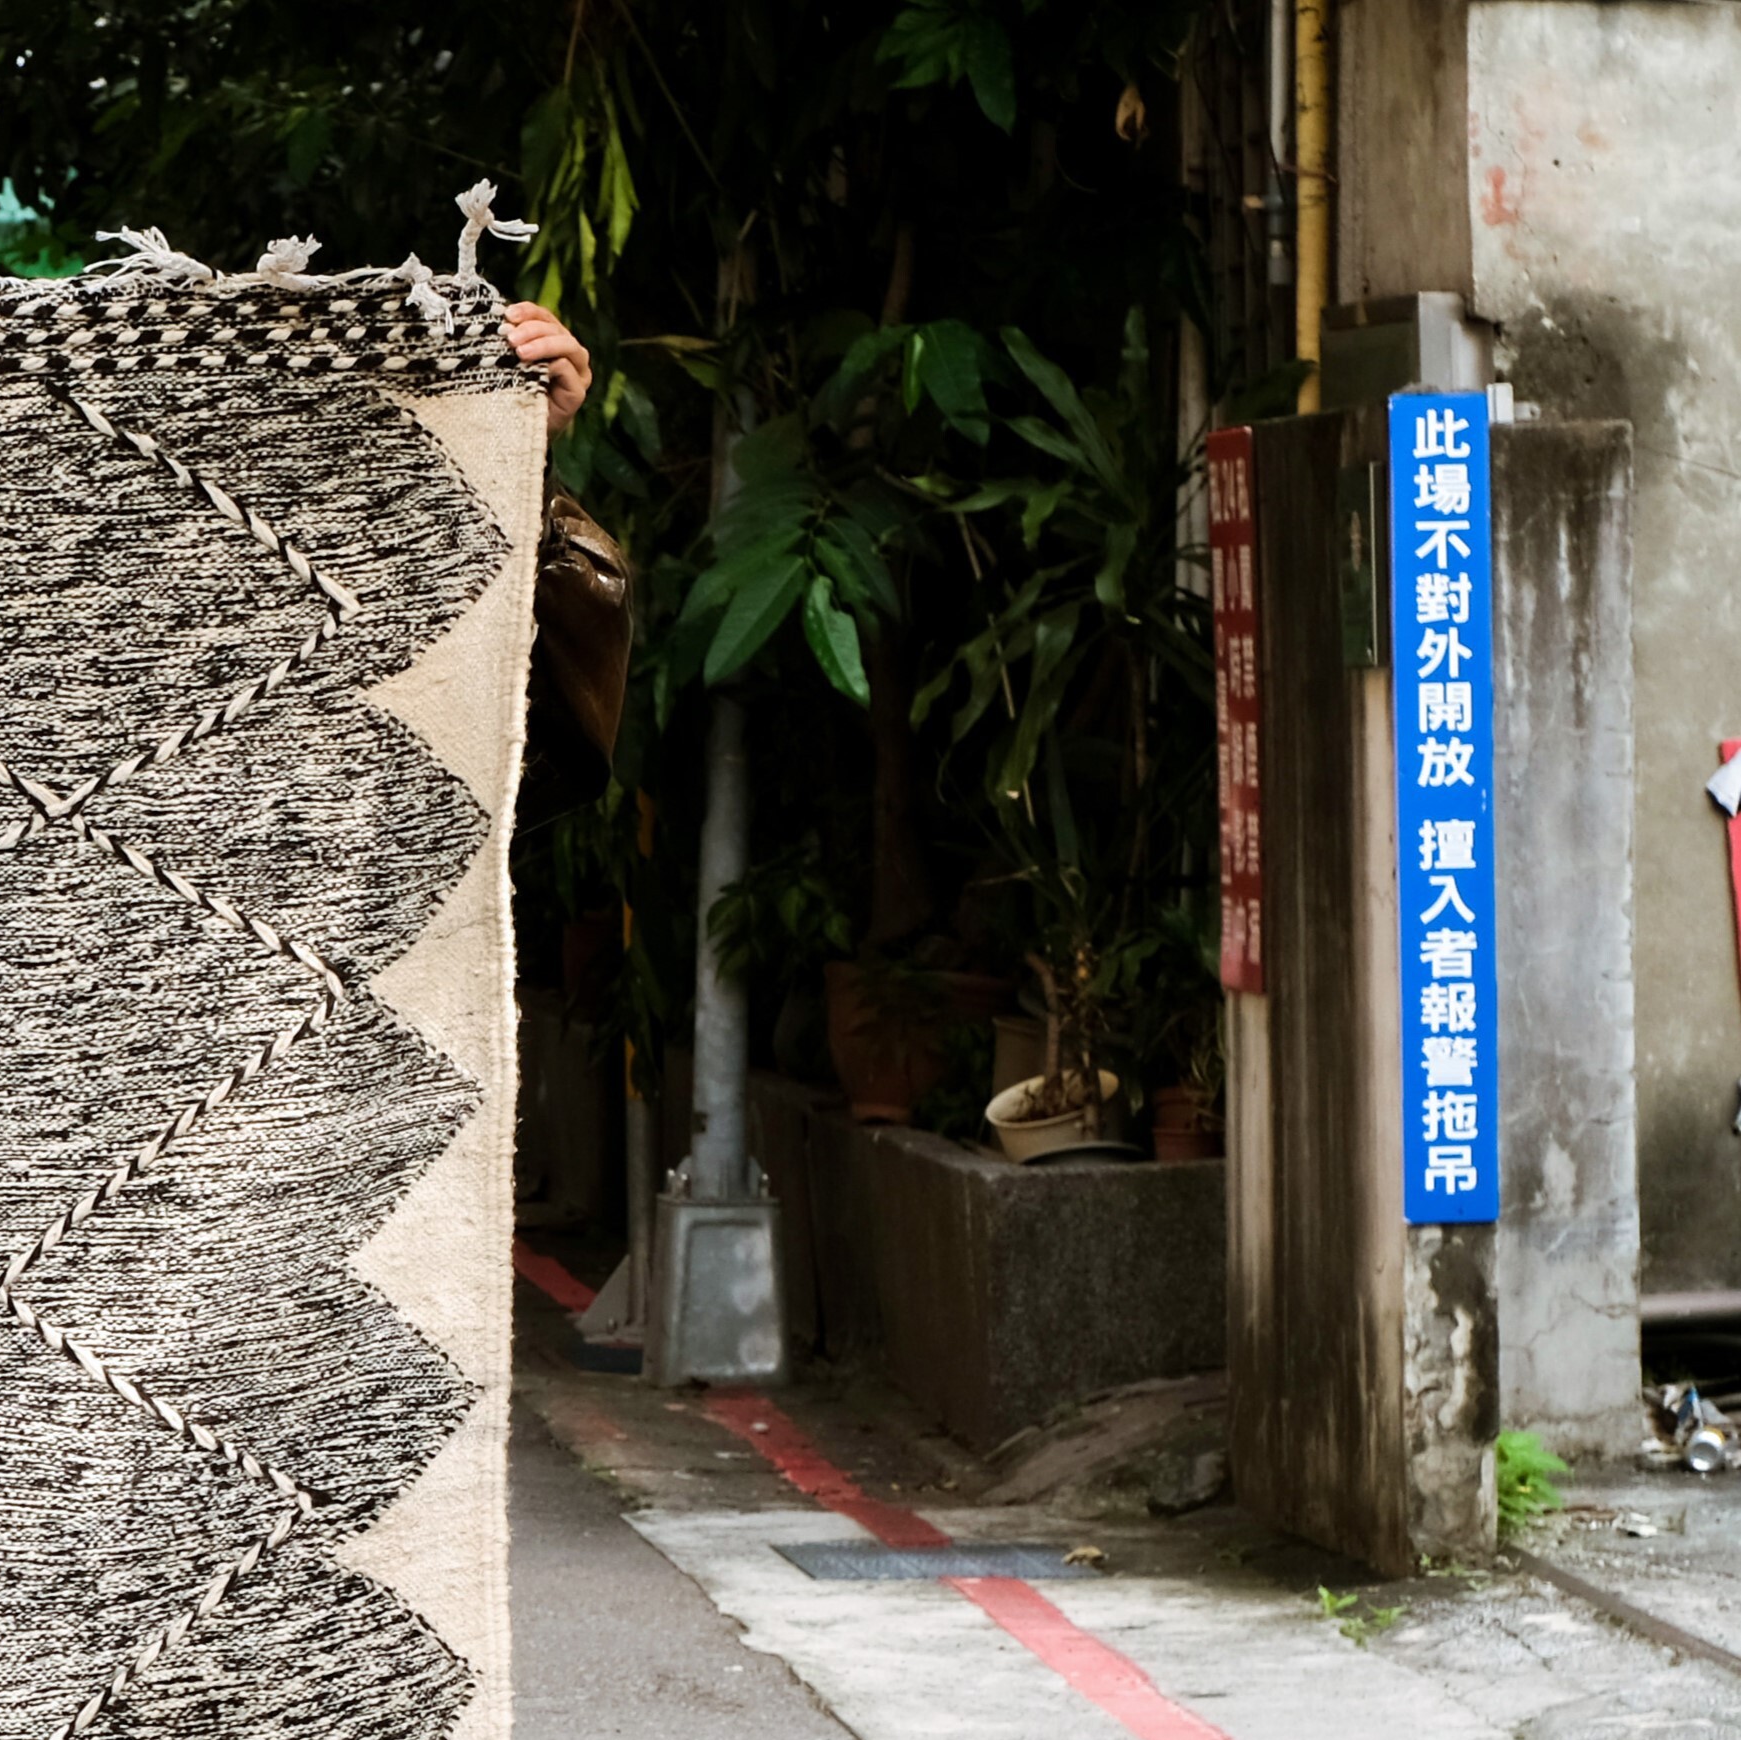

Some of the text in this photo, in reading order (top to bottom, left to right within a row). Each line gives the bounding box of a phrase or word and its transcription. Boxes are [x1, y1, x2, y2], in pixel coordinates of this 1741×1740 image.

[1413, 408, 1478, 1195] 此場不對外開放 擅入者報警拖吊
